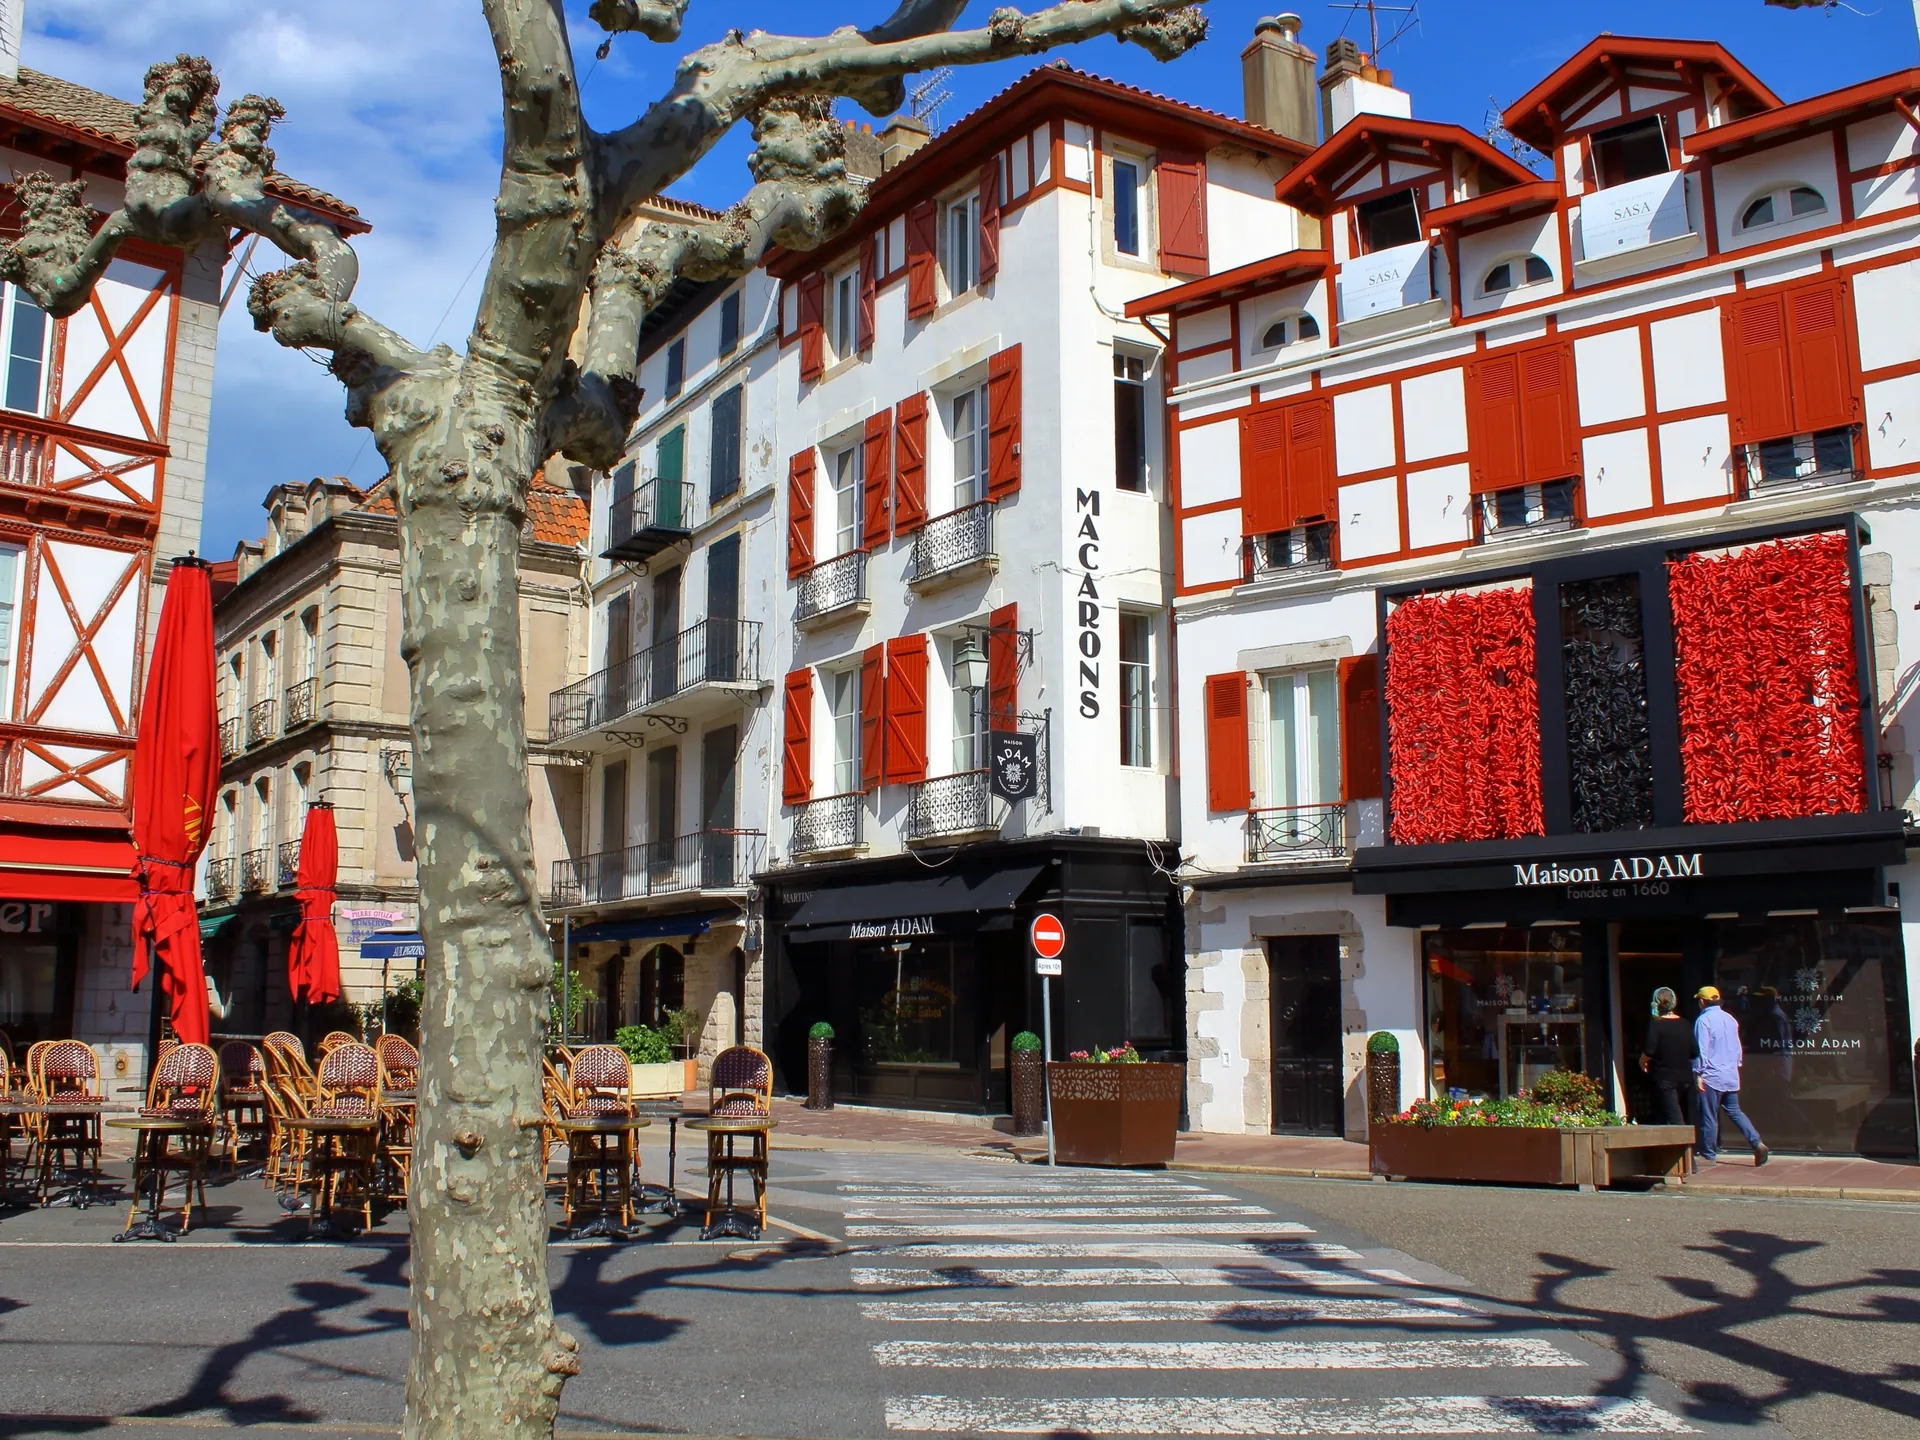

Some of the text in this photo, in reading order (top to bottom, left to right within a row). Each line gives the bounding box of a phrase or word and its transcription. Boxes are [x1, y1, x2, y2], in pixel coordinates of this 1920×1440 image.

[1613, 201, 1651, 221] SASA
[1368, 268, 1400, 286] SASA
[1076, 486, 1101, 720] MACARONS
[996, 748, 1032, 769] ADAM
[1513, 853, 1704, 886] Maison ADAM
[1612, 887, 1627, 897] en
[1633, 881, 1670, 896] 1660
[849, 916, 935, 939] Maison ADAM
[1774, 993, 1844, 1002] MAISON ADAM
[1760, 1037, 1861, 1049] MAISON ADAM
